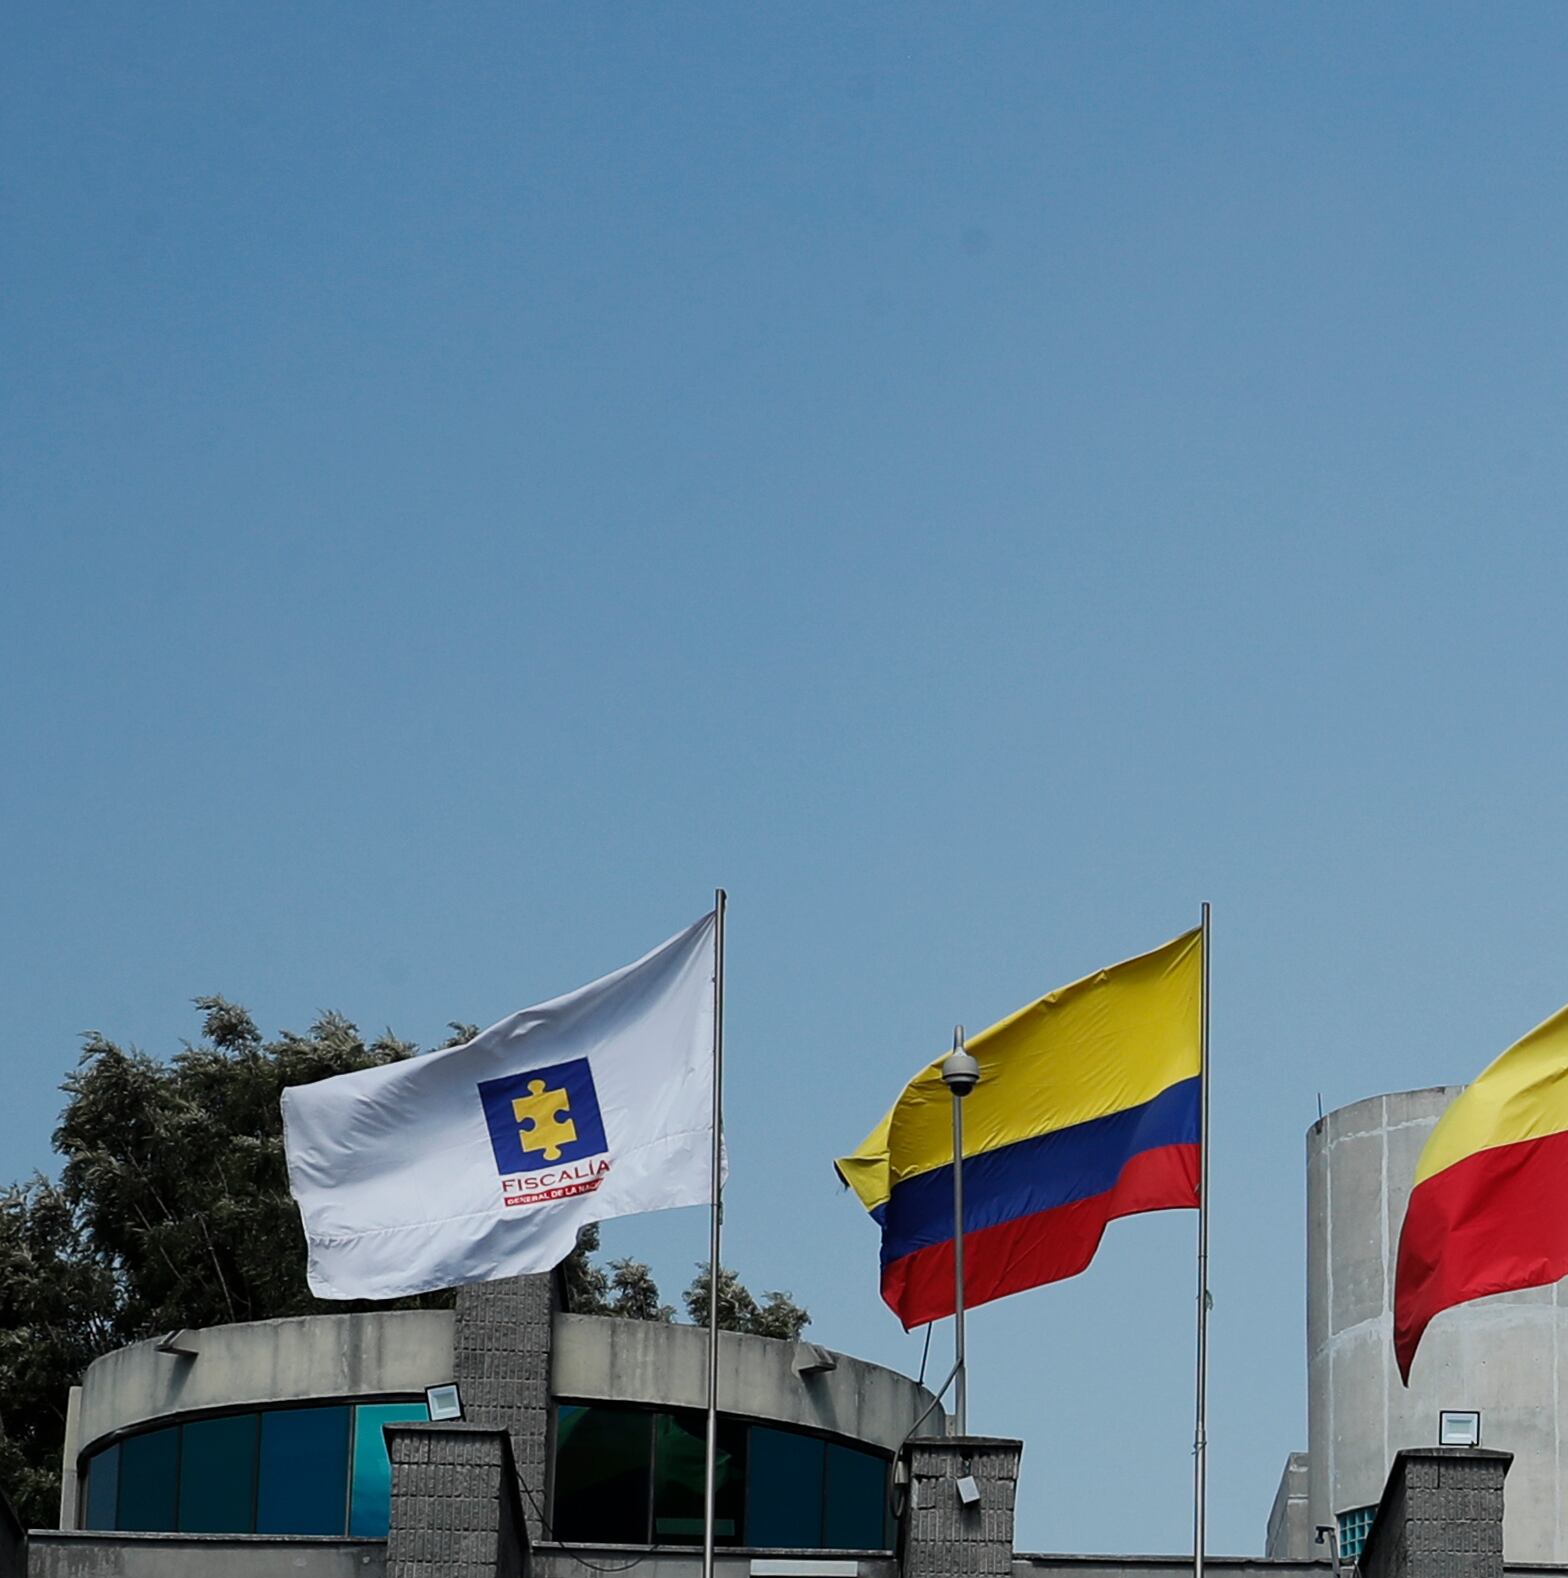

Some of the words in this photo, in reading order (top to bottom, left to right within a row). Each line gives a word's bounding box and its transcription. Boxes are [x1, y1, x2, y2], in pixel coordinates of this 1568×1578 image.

[506, 1193, 549, 1205] GENERAL
[550, 1189, 563, 1198] DE
[565, 1186, 578, 1195] LA
